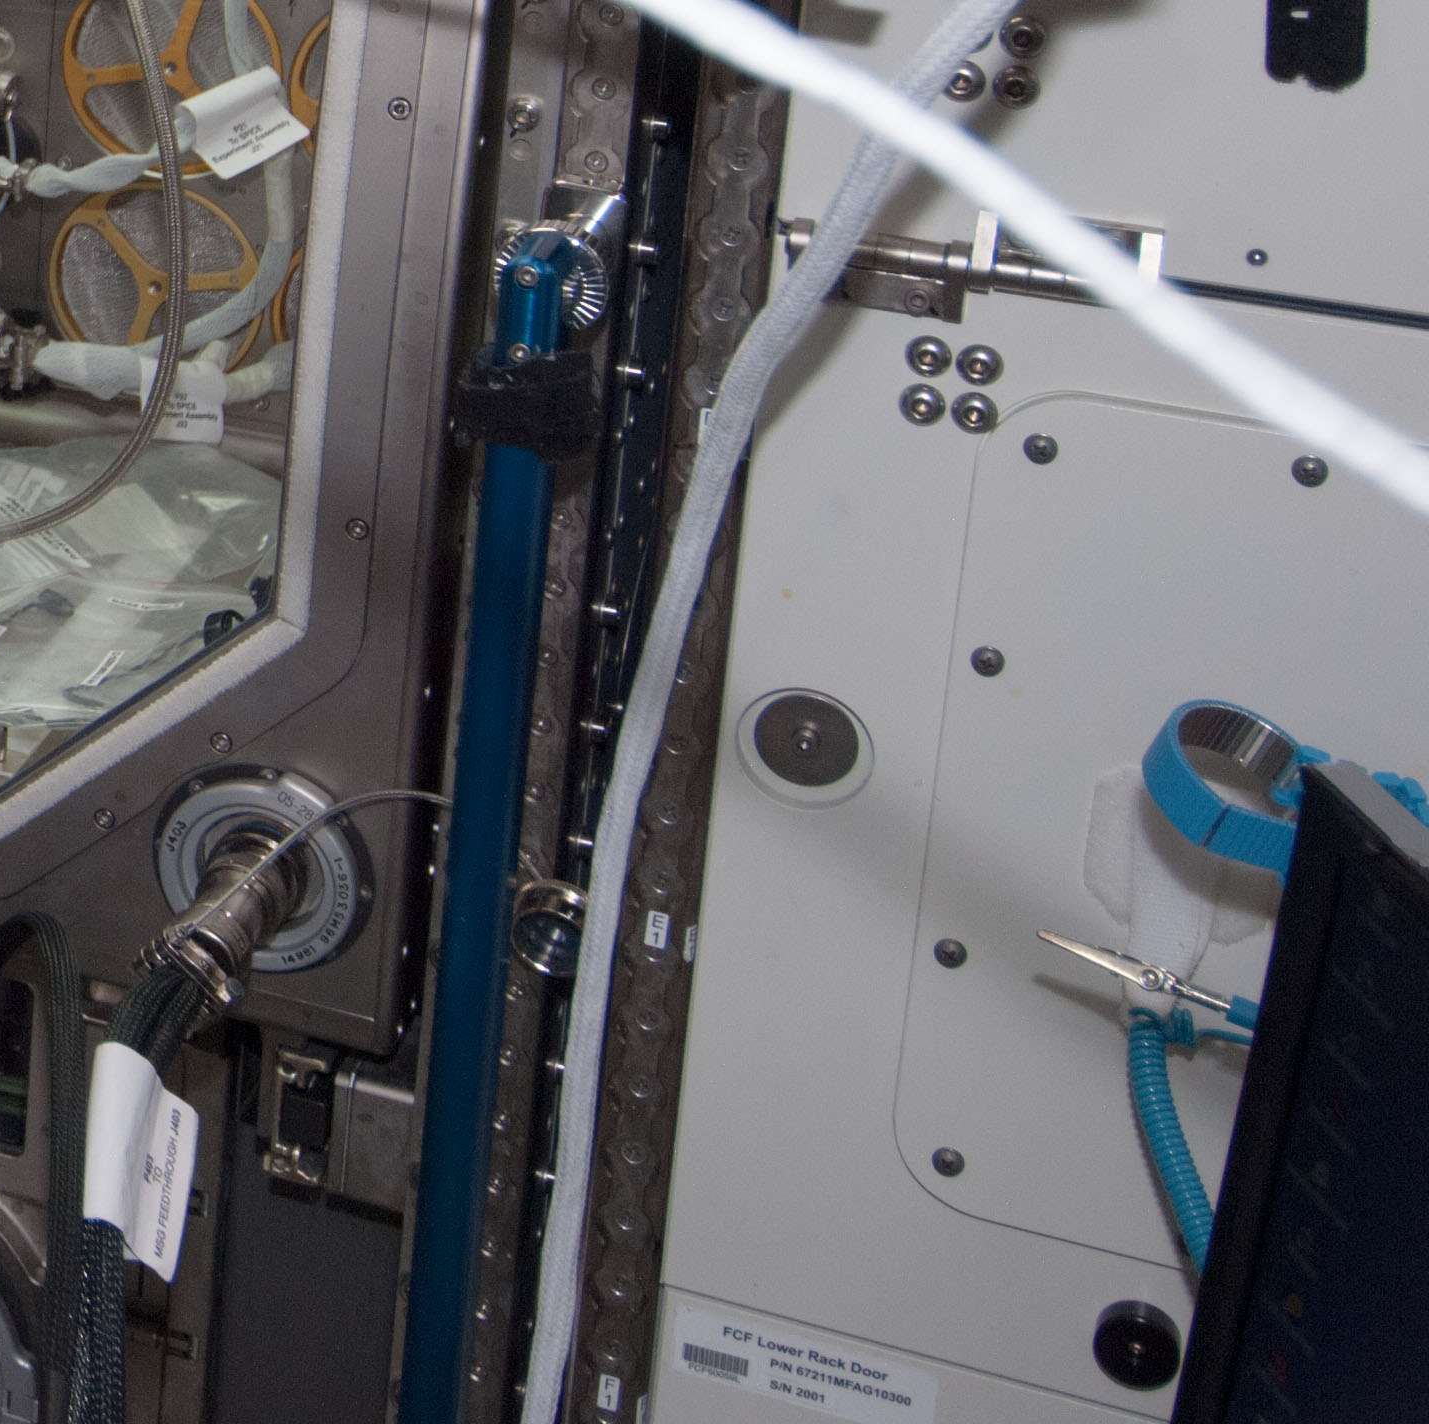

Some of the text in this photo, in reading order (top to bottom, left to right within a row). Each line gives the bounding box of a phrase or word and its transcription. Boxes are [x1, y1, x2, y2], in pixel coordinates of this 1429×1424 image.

[166, 819, 188, 853] J403
[152, 1165, 163, 1184] TO
[157, 1136, 178, 1230] FEEDTHROUGH
[154, 1228, 167, 1260] MSG
[722, 1325, 890, 1383] FCF Lower Rack Door
[769, 1357, 793, 1375] P/N
[769, 1379, 826, 1405] S/N 2001
